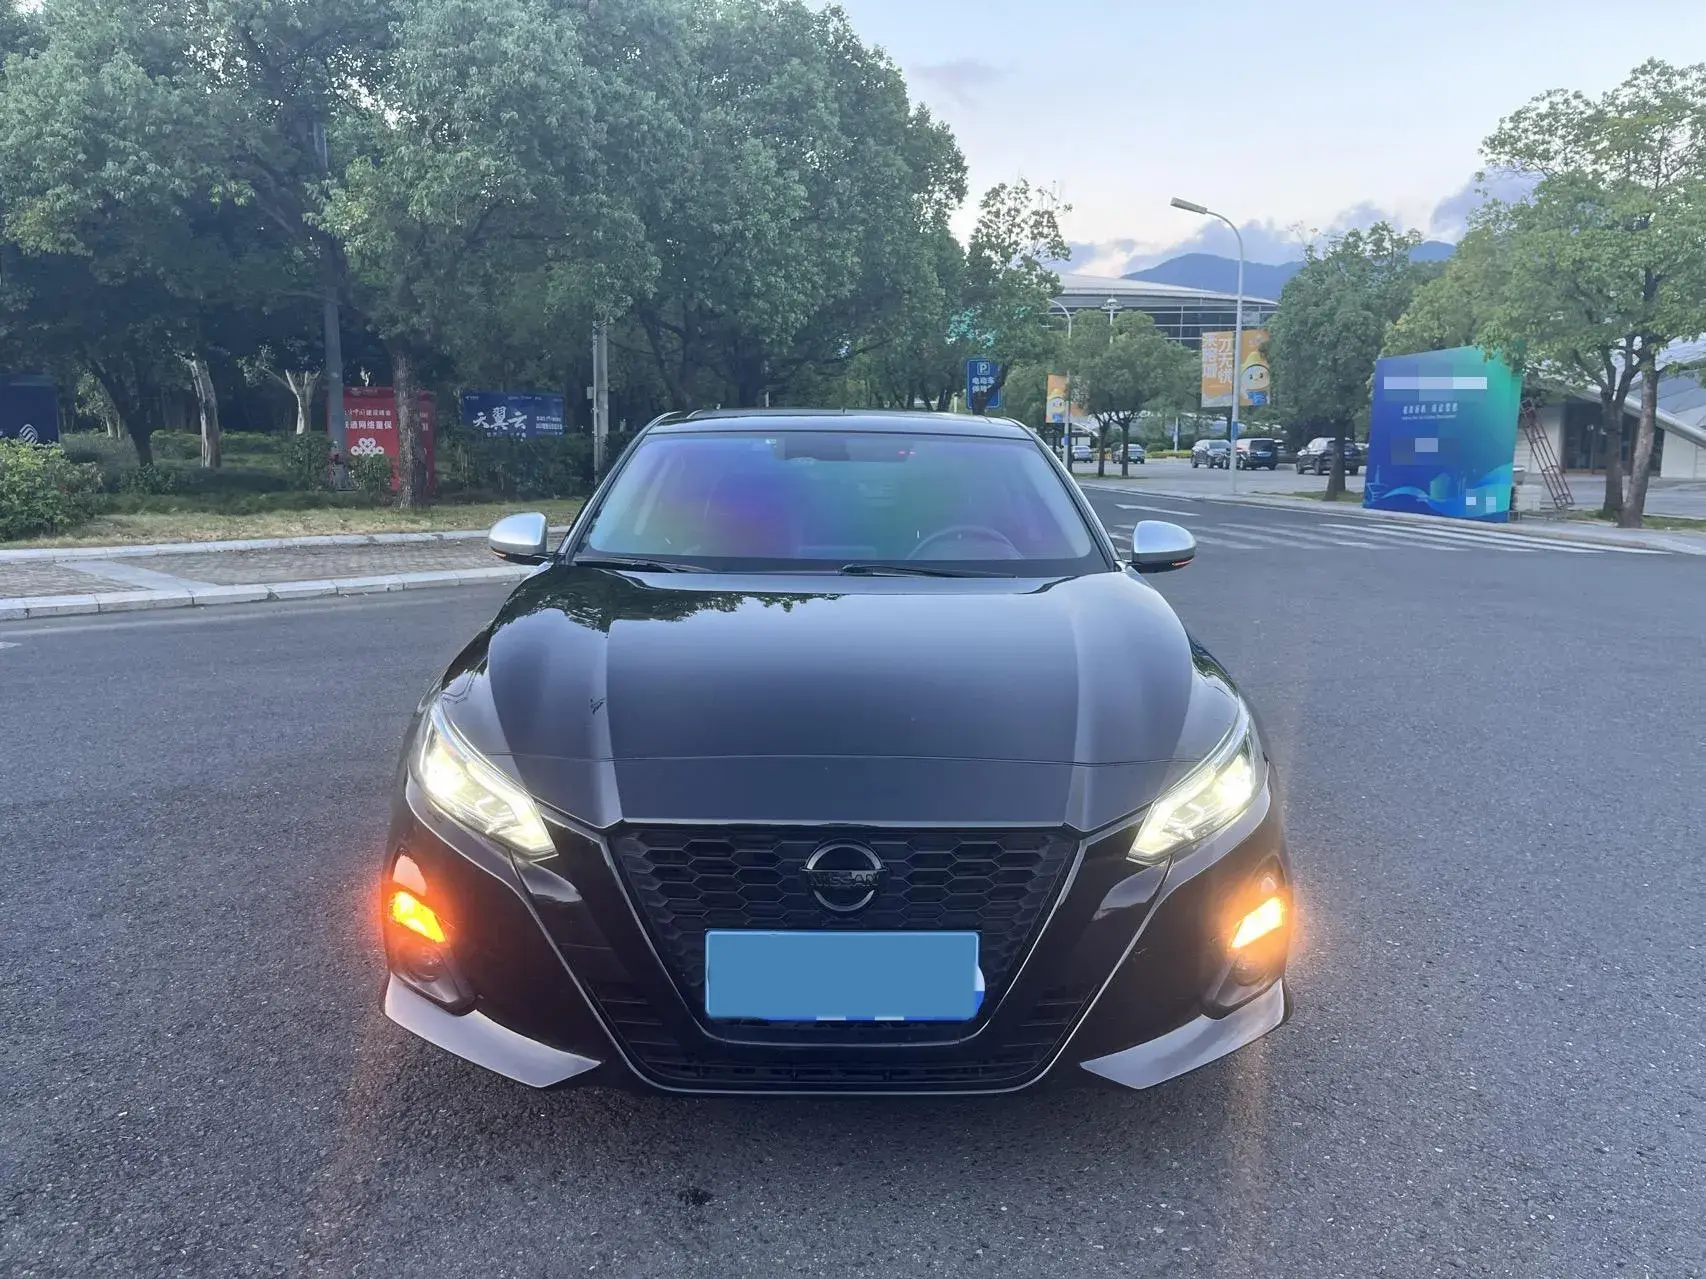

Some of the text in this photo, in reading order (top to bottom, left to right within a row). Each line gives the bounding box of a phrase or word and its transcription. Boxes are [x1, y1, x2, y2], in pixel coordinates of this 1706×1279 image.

[472, 406, 528, 430] 天翼云
[809, 871, 880, 887] NISSAN
